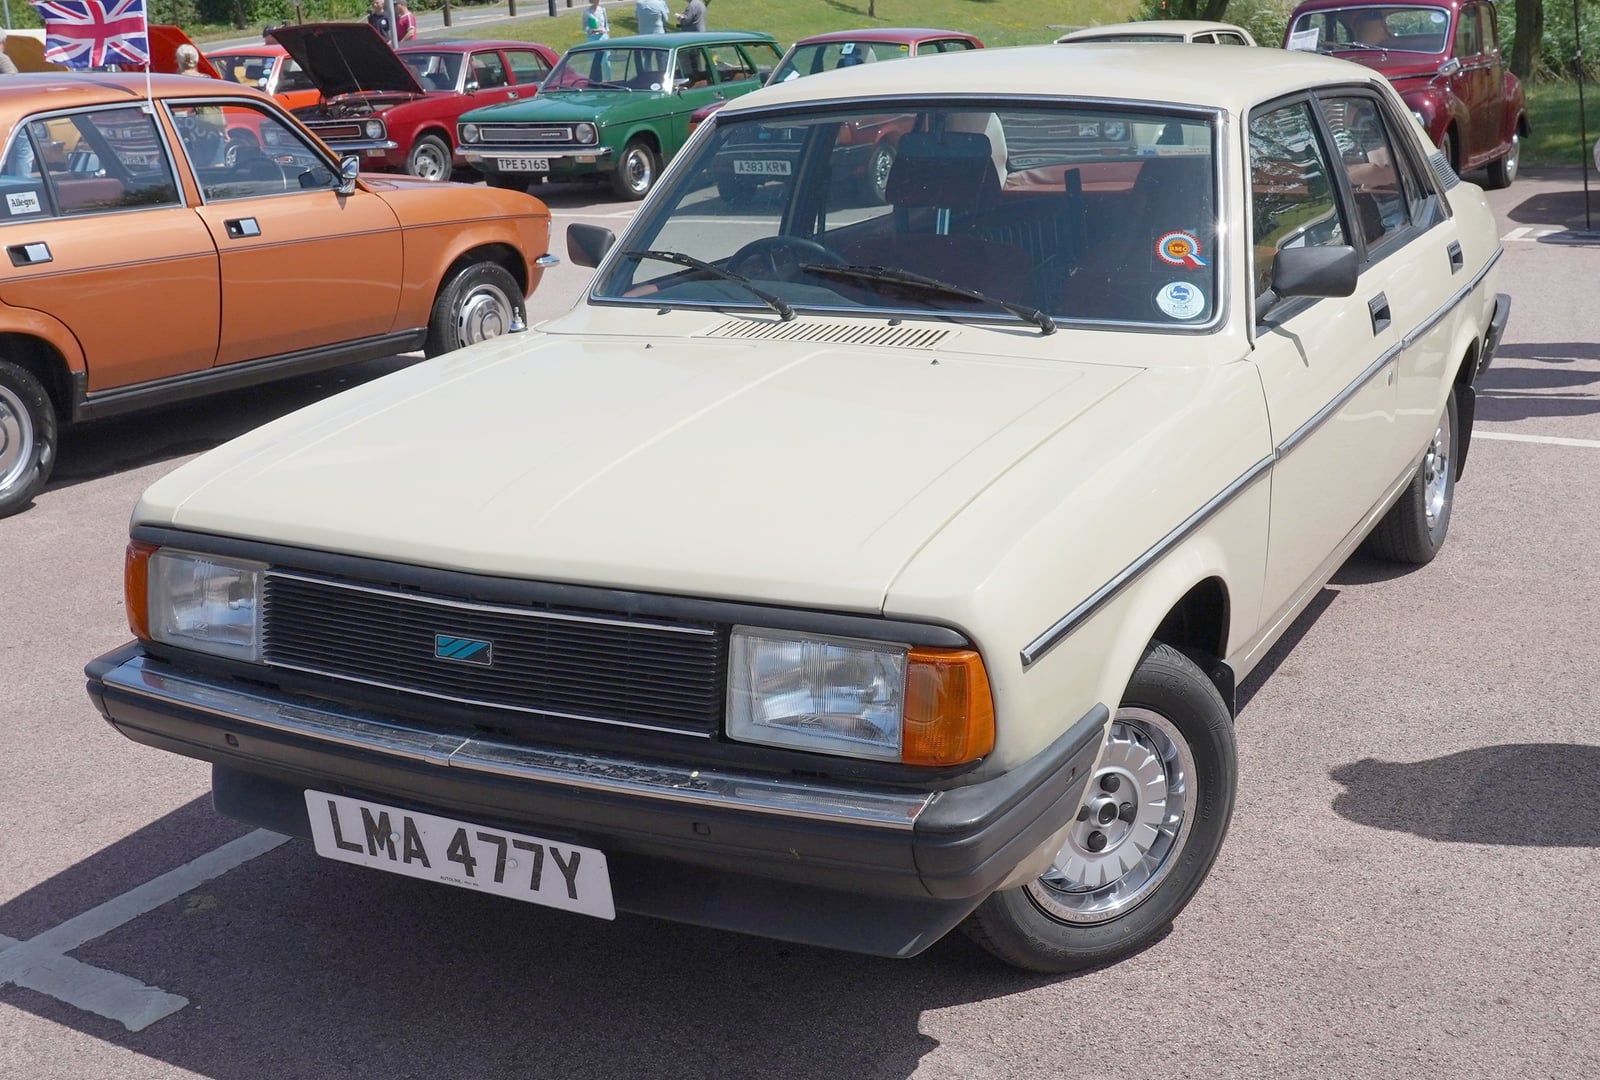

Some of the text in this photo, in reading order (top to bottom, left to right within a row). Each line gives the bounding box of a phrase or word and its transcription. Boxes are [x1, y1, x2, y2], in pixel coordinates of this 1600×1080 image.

[499, 159, 547, 170] TPE 516S
[738, 161, 787, 173] A383 KRW
[327, 800, 581, 900] LMA 477Y
